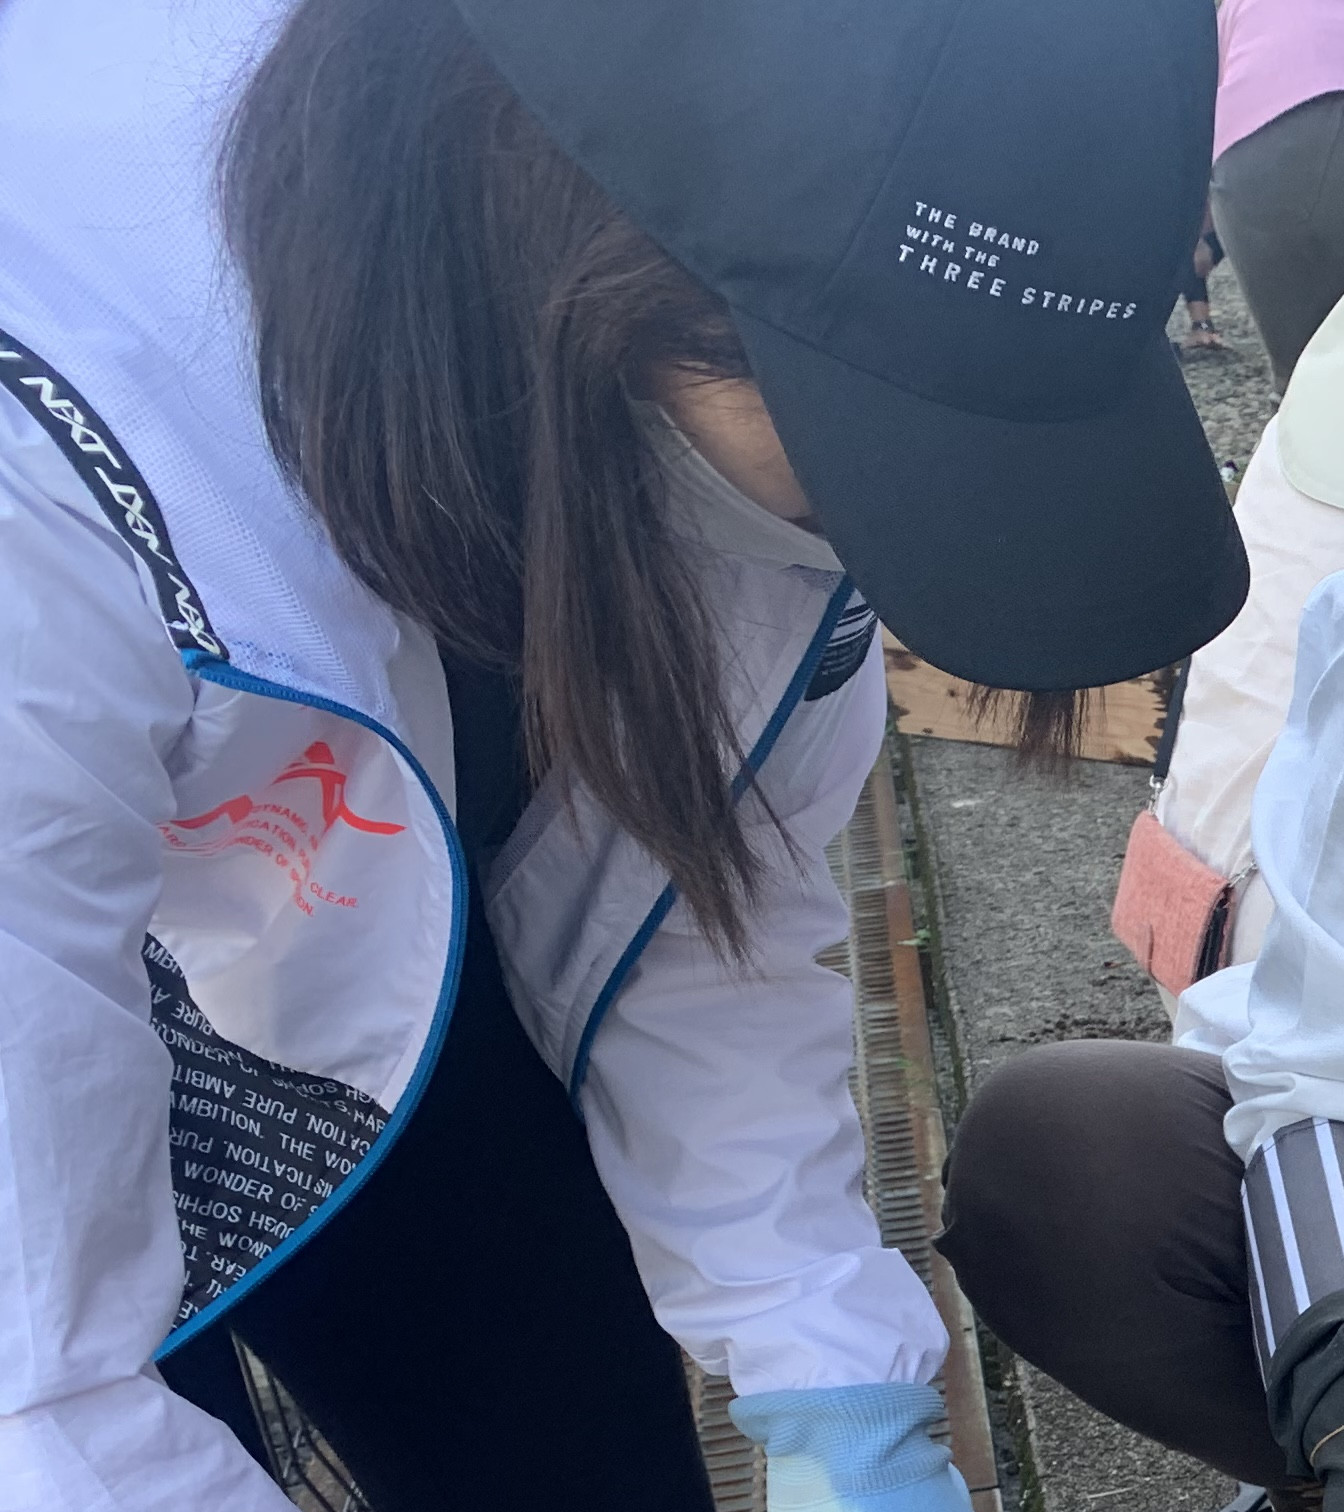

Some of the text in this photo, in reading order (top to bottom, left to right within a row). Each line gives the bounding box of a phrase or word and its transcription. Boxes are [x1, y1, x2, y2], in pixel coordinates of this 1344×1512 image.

[906, 225, 1000, 267] WITH THE
[915, 201, 1040, 255] THE BRAND
[899, 244, 1137, 319] THREE STRIPES
[243, 1089, 298, 1125] PURE
[279, 1133, 316, 1162] THE
[184, 1159, 274, 1203] WONDER
